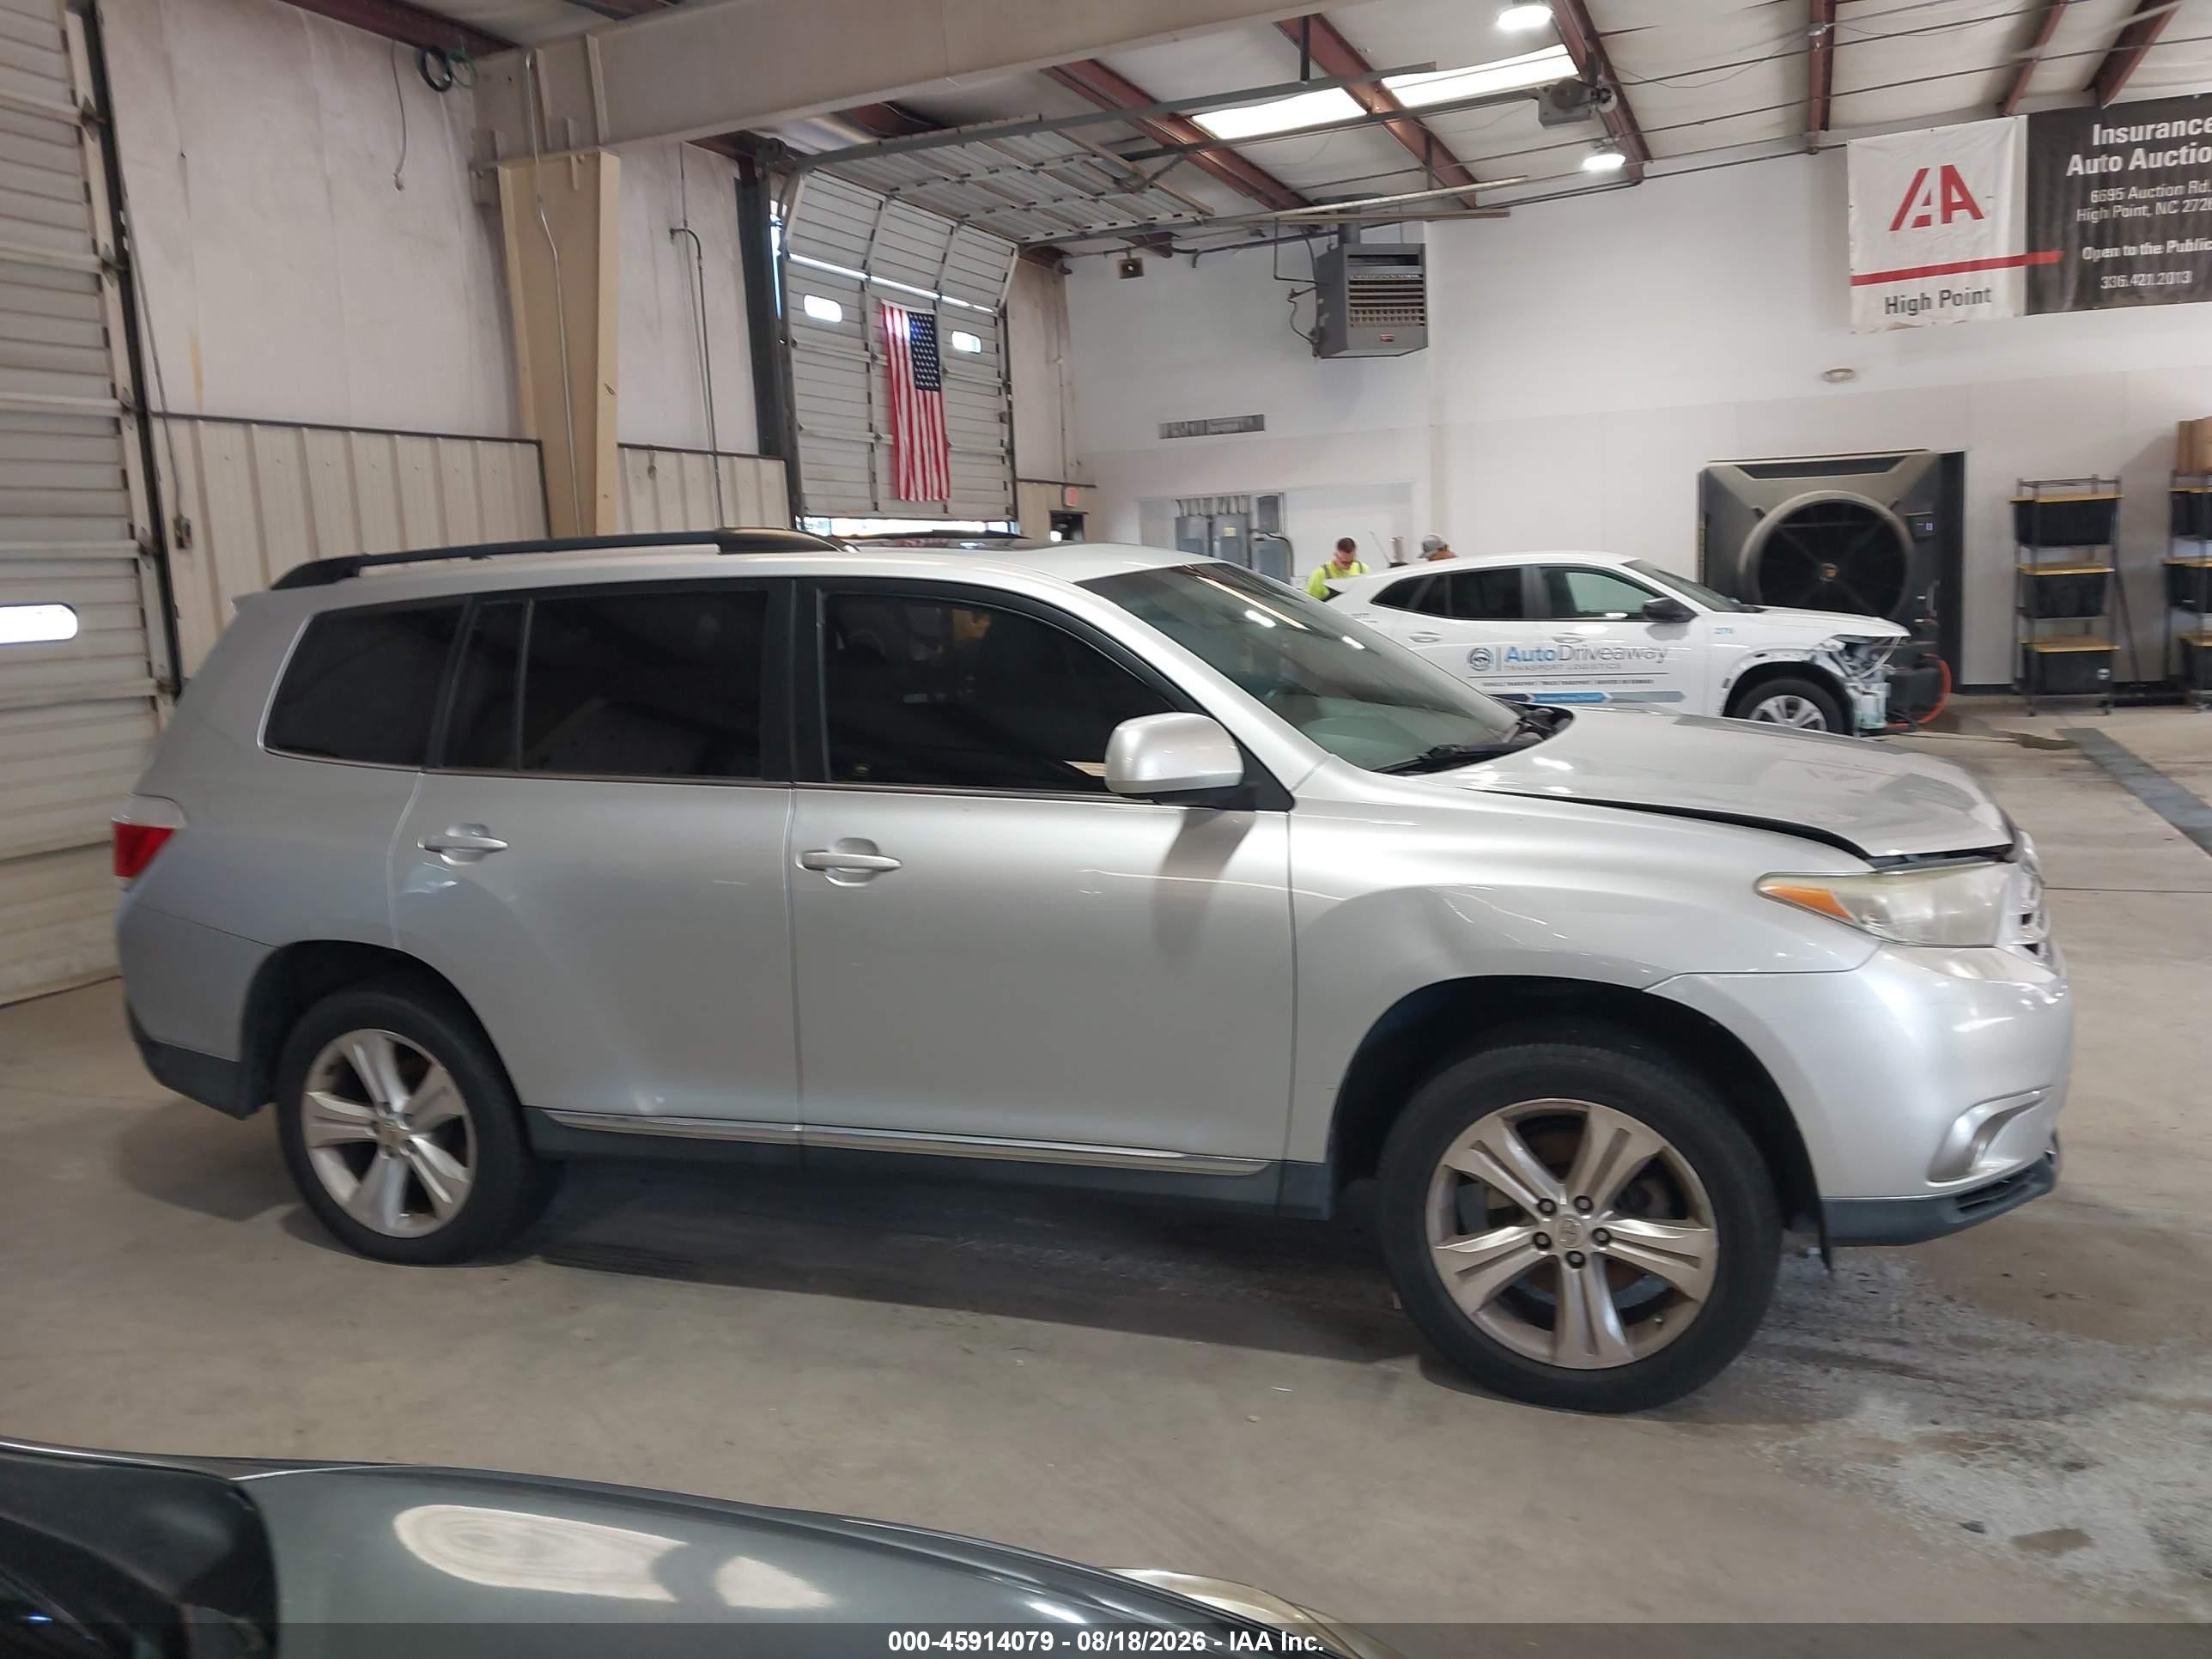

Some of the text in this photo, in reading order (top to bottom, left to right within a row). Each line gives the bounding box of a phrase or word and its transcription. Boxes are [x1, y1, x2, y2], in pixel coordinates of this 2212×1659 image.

[2092, 116, 2212, 146] Insurance
[2066, 142, 2212, 177] Auto Auctio
[2090, 186, 2124, 204] 6695
[2127, 183, 2185, 200] Auction
[2075, 207, 2111, 223] High
[2112, 204, 2153, 218] Point,
[2155, 199, 2179, 216] NC
[2081, 246, 2120, 262] Open
[2123, 244, 2139, 257] to
[2140, 240, 2163, 256] the
[1884, 287, 1992, 317] High Point
[1504, 644, 1668, 664] AutoDriveaway
